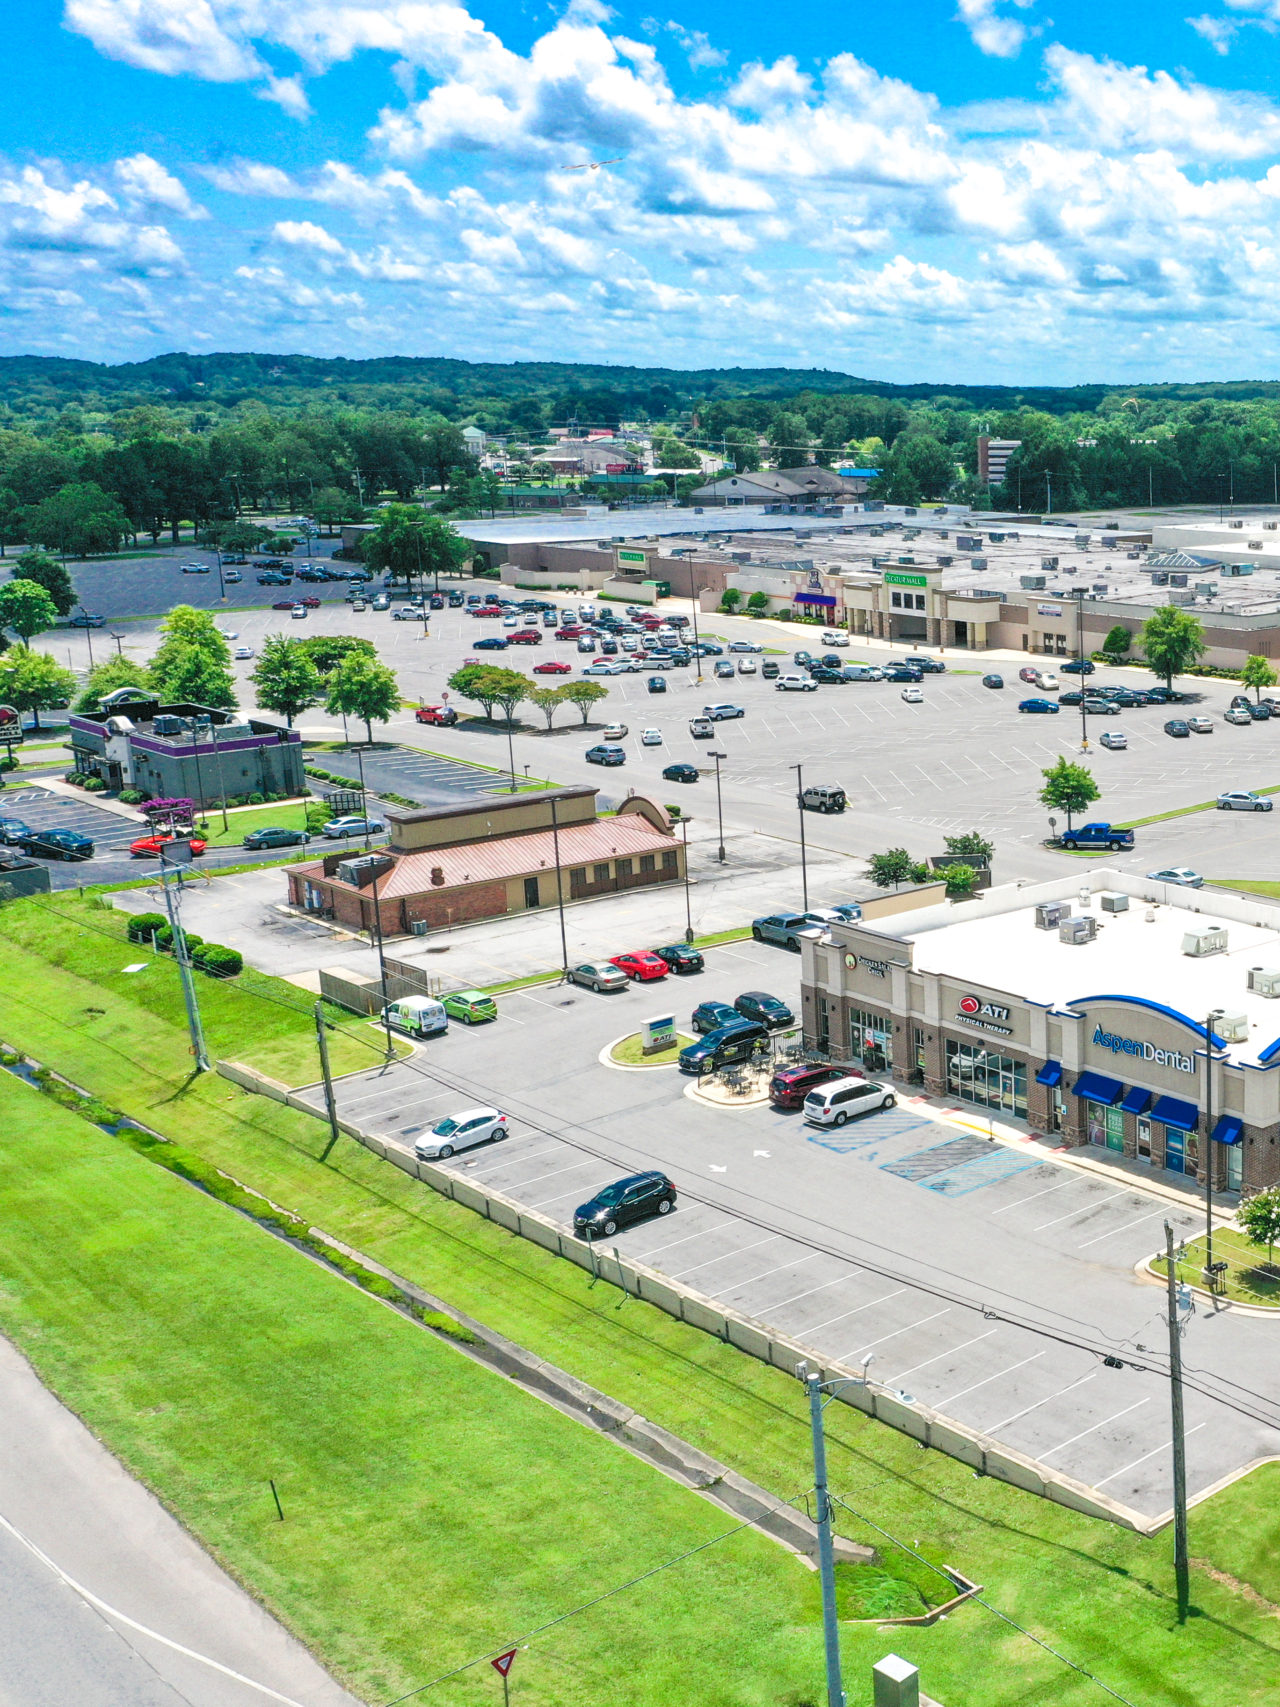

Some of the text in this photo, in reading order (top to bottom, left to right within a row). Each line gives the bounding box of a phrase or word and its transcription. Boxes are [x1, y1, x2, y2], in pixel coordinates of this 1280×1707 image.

[981, 1003, 1009, 1021] ATI
[955, 1014, 1013, 1036] PHYSICAL THERAPY
